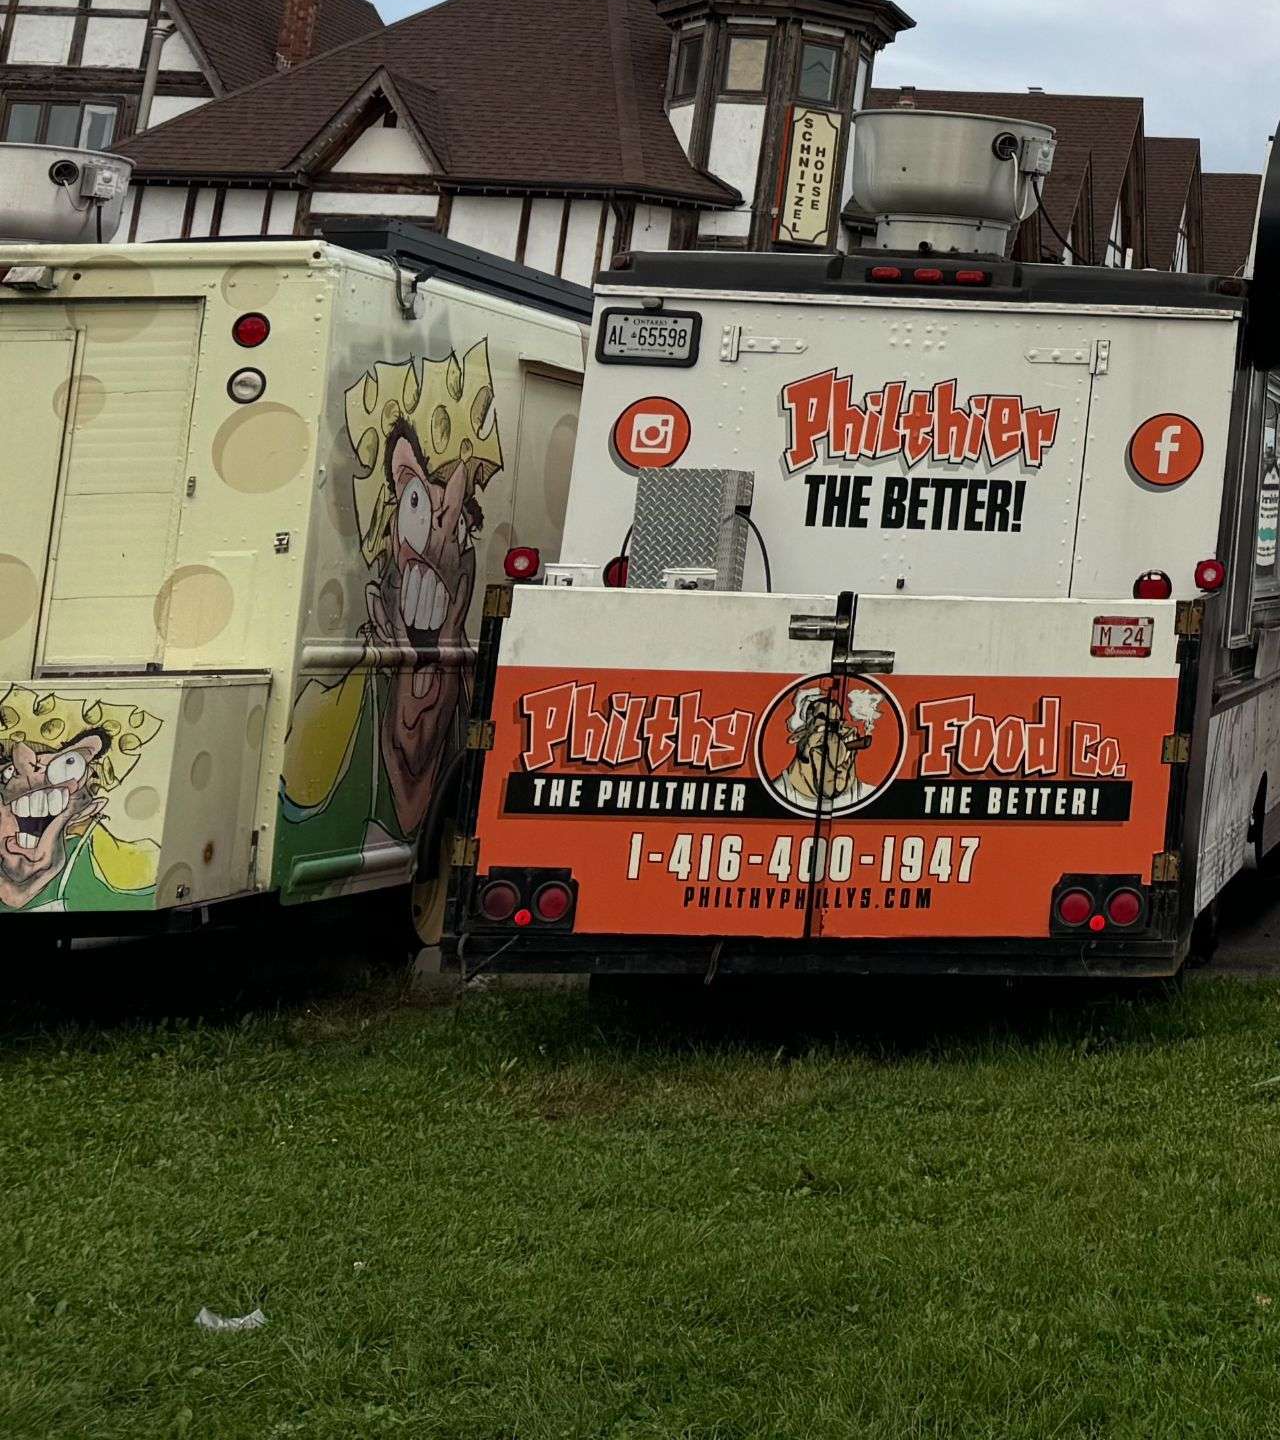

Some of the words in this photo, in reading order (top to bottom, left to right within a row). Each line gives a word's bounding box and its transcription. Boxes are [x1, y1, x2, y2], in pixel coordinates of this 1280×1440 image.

[791, 118, 814, 233] SCHNITZEL
[811, 146, 826, 210] HOUSE
[781, 367, 1060, 472] Philthier
[803, 474, 872, 528] THE
[880, 476, 1027, 533] BETTER!
[1122, 627, 1144, 646] 24
[520, 680, 754, 772] Philthy
[919, 695, 1061, 779] Food
[1070, 720, 1126, 778] Co.
[533, 778, 582, 808] THE
[597, 780, 746, 812] PHILTHIER
[923, 786, 972, 814] THE
[987, 787, 1099, 815] BETTER!
[626, 832, 980, 884] 1-416-400-1947
[683, 886, 931, 909] PHILTHYPHILLYS.COM
